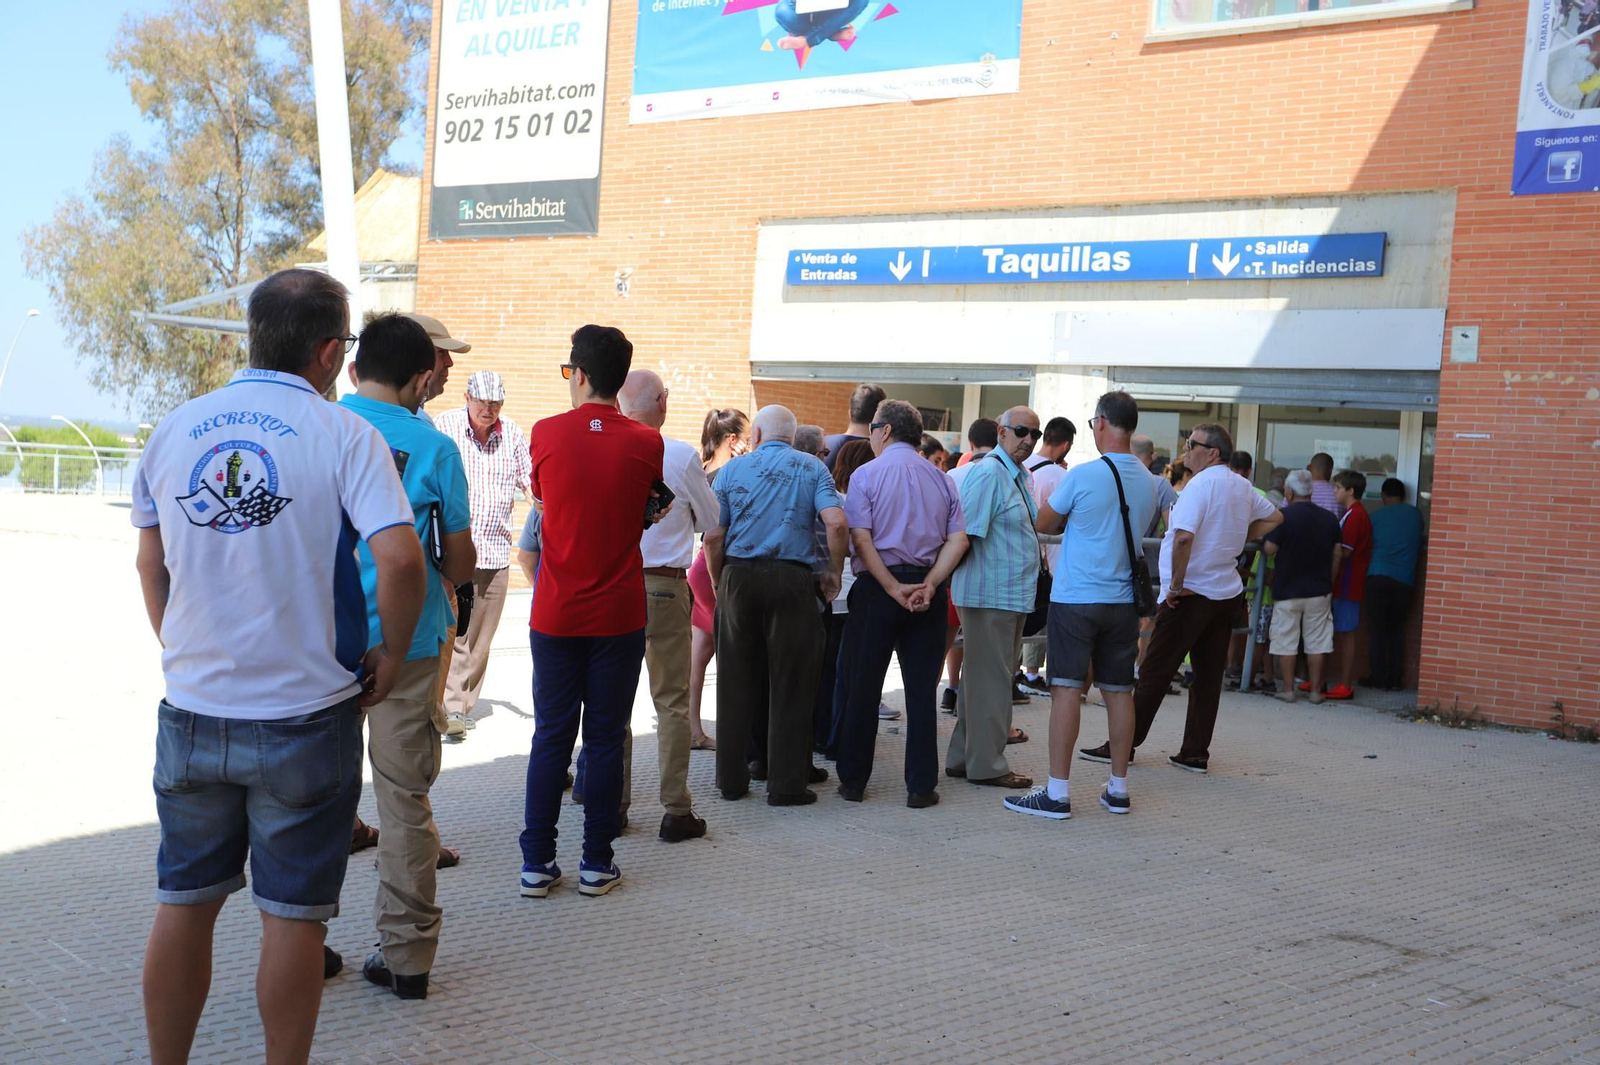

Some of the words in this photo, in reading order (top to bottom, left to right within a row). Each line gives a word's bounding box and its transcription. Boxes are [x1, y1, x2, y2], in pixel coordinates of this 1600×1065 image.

[456, 0, 487, 23] EN
[652, 0, 665, 12] de
[464, 21, 581, 58] ALQUILER
[1539, 13, 1550, 52] TRABAJO
[445, 83, 596, 111] Servihabitat.com
[1534, 81, 1575, 120] FONTANERÍA
[444, 118, 485, 144] 902
[494, 115, 521, 140] 15
[527, 112, 555, 138] 01
[563, 108, 593, 135] 02
[1534, 136, 1580, 147] Síguenos
[1582, 134, 1598, 143] en:
[475, 197, 566, 219] Servihabitat
[801, 253, 838, 264] Venta
[841, 252, 857, 264] de
[1254, 241, 1309, 255] Salida
[982, 245, 1131, 279] Taquillas
[1252, 261, 1266, 275] T.
[1272, 258, 1376, 275] Incidencias
[801, 269, 857, 280] Entradas
[189, 411, 298, 440] RECRESLOT
[219, 442, 260, 452] CULTURAL
